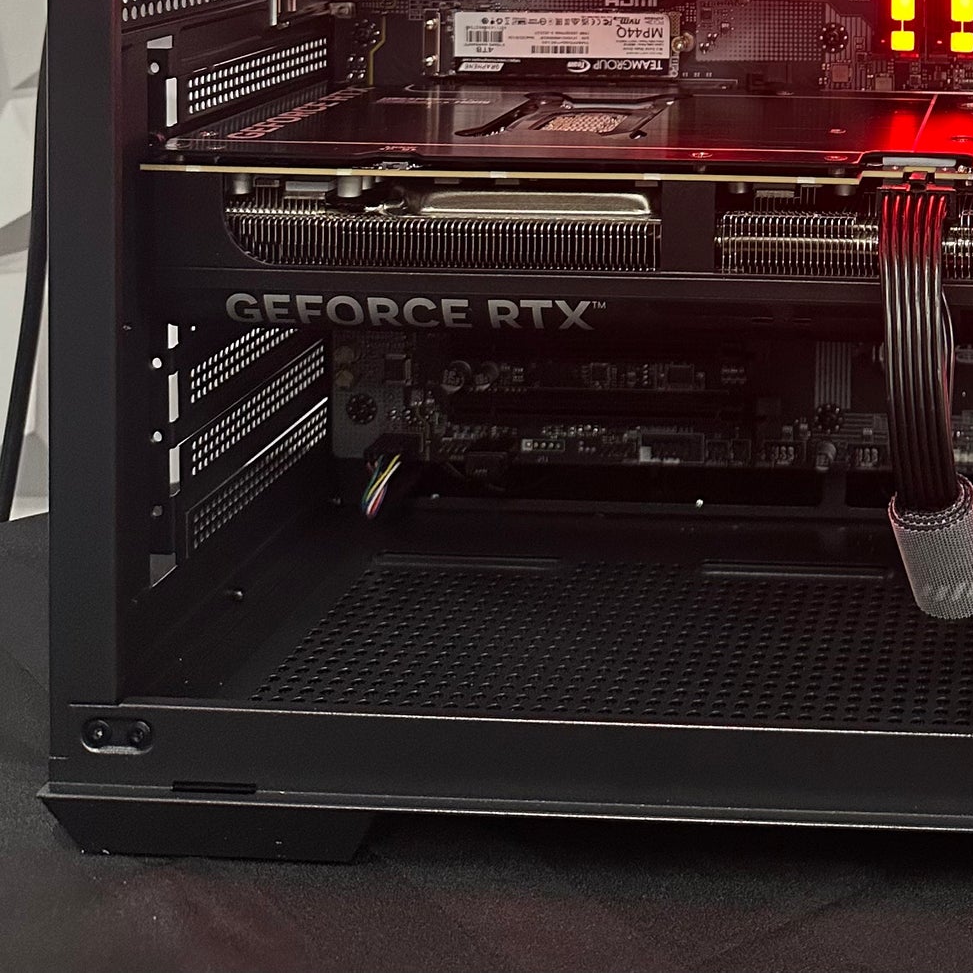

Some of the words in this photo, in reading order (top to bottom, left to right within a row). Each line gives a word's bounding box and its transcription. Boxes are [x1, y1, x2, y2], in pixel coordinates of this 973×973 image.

[616, 25, 664, 38] MP44Q
[593, 59, 663, 70] TEAMGROUP
[225, 293, 470, 328] GEFORCE
